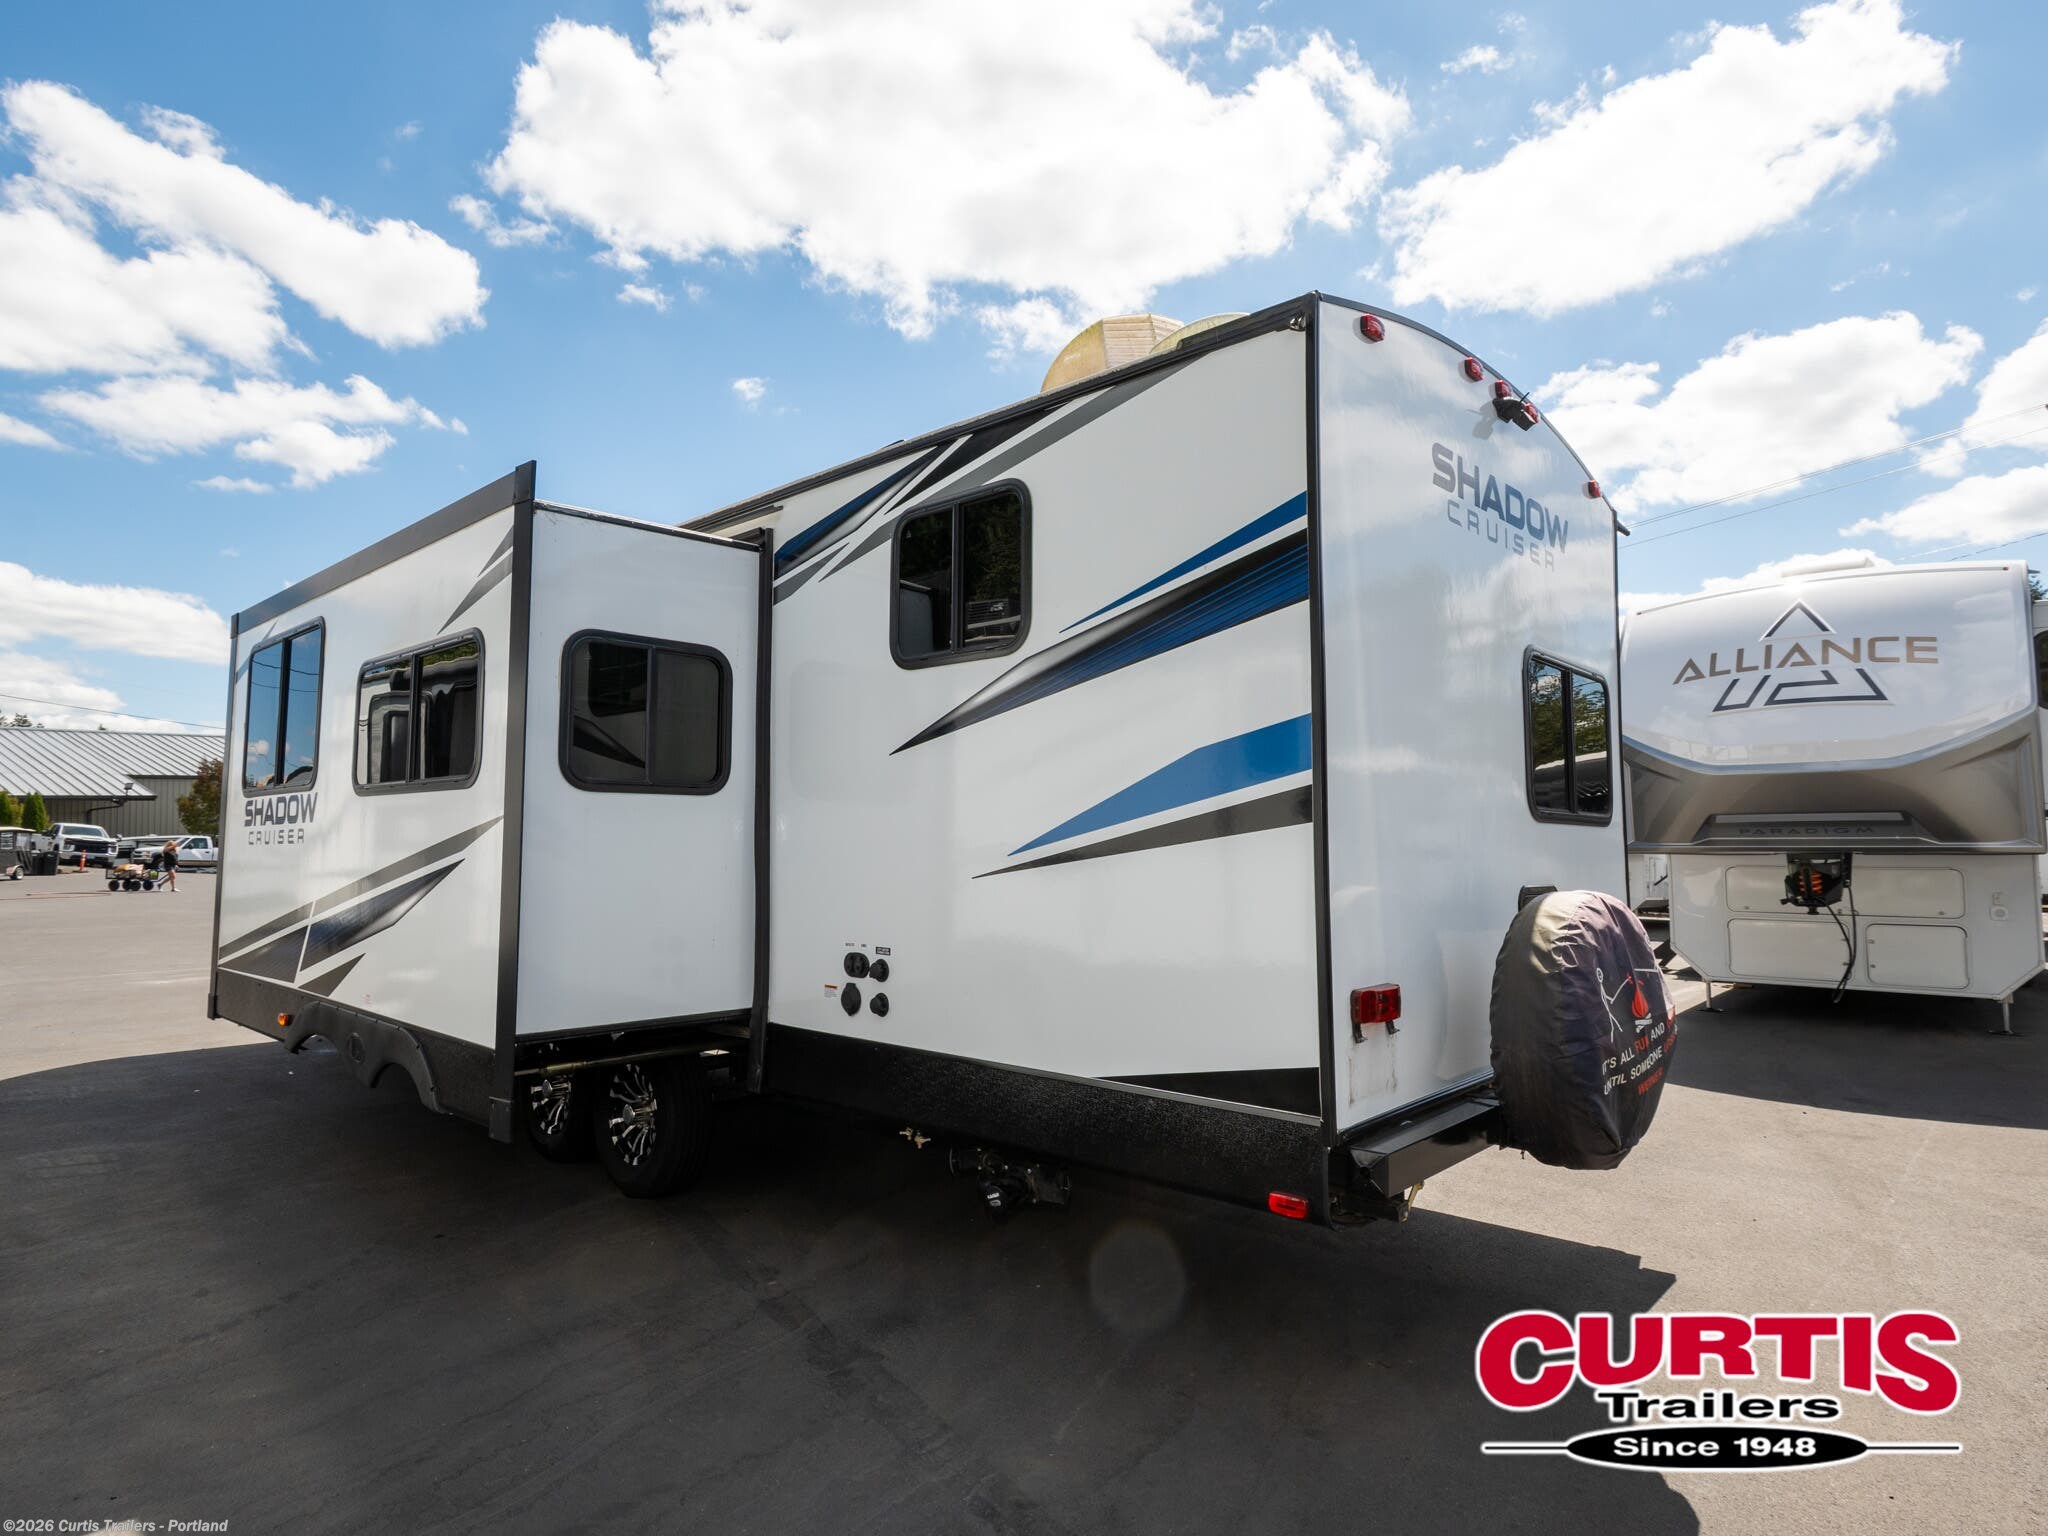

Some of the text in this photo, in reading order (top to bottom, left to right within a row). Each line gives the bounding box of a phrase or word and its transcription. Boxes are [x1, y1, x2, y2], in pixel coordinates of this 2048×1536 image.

[1432, 442, 1568, 554] SHADOW
[1447, 499, 1555, 572] CRUISER
[1673, 636, 1938, 685] ALLIANCE
[244, 792, 318, 827] SHADOW
[1739, 824, 1873, 835] PARADIGM
[248, 828, 305, 846] CRUISER
[1621, 1048, 1635, 1064] ALL
[1651, 1022, 1665, 1041] AND
[1604, 1074, 1627, 1095] UNTIL
[1631, 1046, 1662, 1079] SOMEONE
